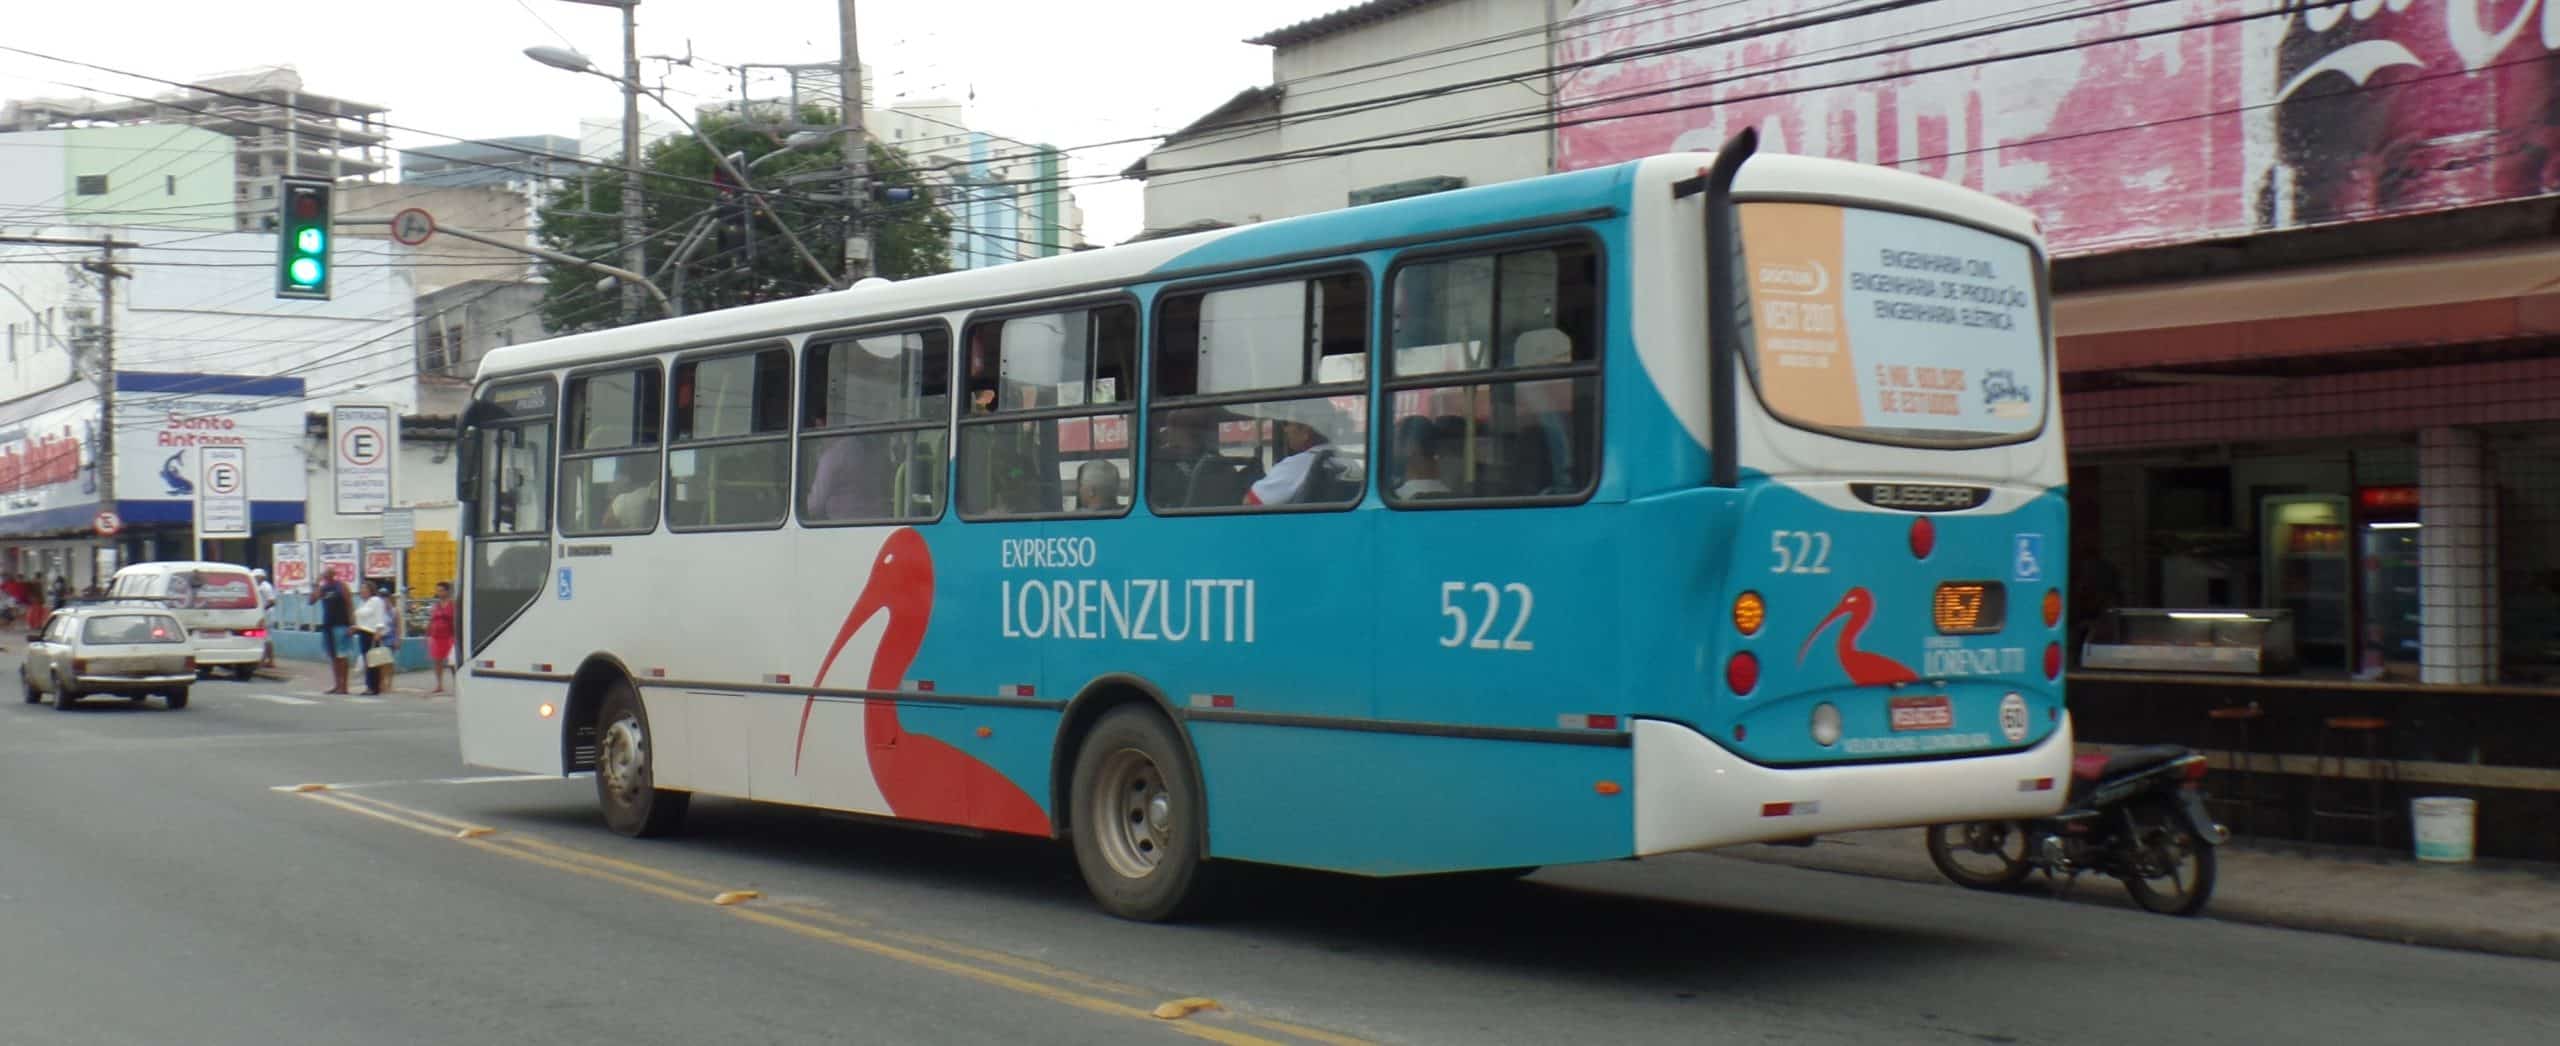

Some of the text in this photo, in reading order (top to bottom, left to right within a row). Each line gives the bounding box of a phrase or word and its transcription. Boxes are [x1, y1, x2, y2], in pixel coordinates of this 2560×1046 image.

[1940, 280, 1960, 300] DE
[167, 411, 236, 431] Santo
[353, 434, 373, 458] E
[216, 469, 232, 488] E
[1873, 485, 1973, 506] BUSSCAR
[1002, 537, 1096, 568] EXPRESSO
[1770, 529, 1833, 575] 522
[1002, 579, 1255, 643] LORENZUTTI
[1439, 581, 1535, 651] 522
[1923, 648, 2026, 677] LORENZUTTI
